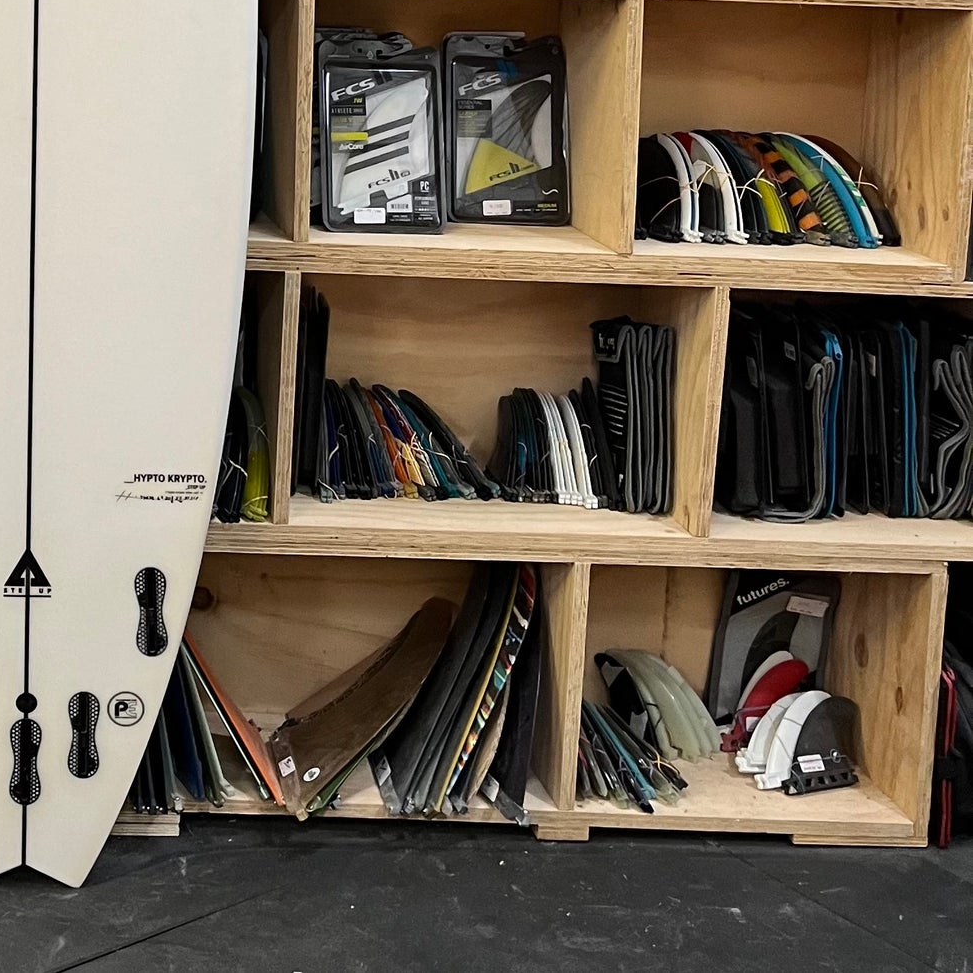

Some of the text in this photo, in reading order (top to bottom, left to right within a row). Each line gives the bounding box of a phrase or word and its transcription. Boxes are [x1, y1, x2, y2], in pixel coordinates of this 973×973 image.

[330, 78, 376, 102] FCS
[458, 73, 502, 96] FCS
[736, 577, 790, 606] futures.
